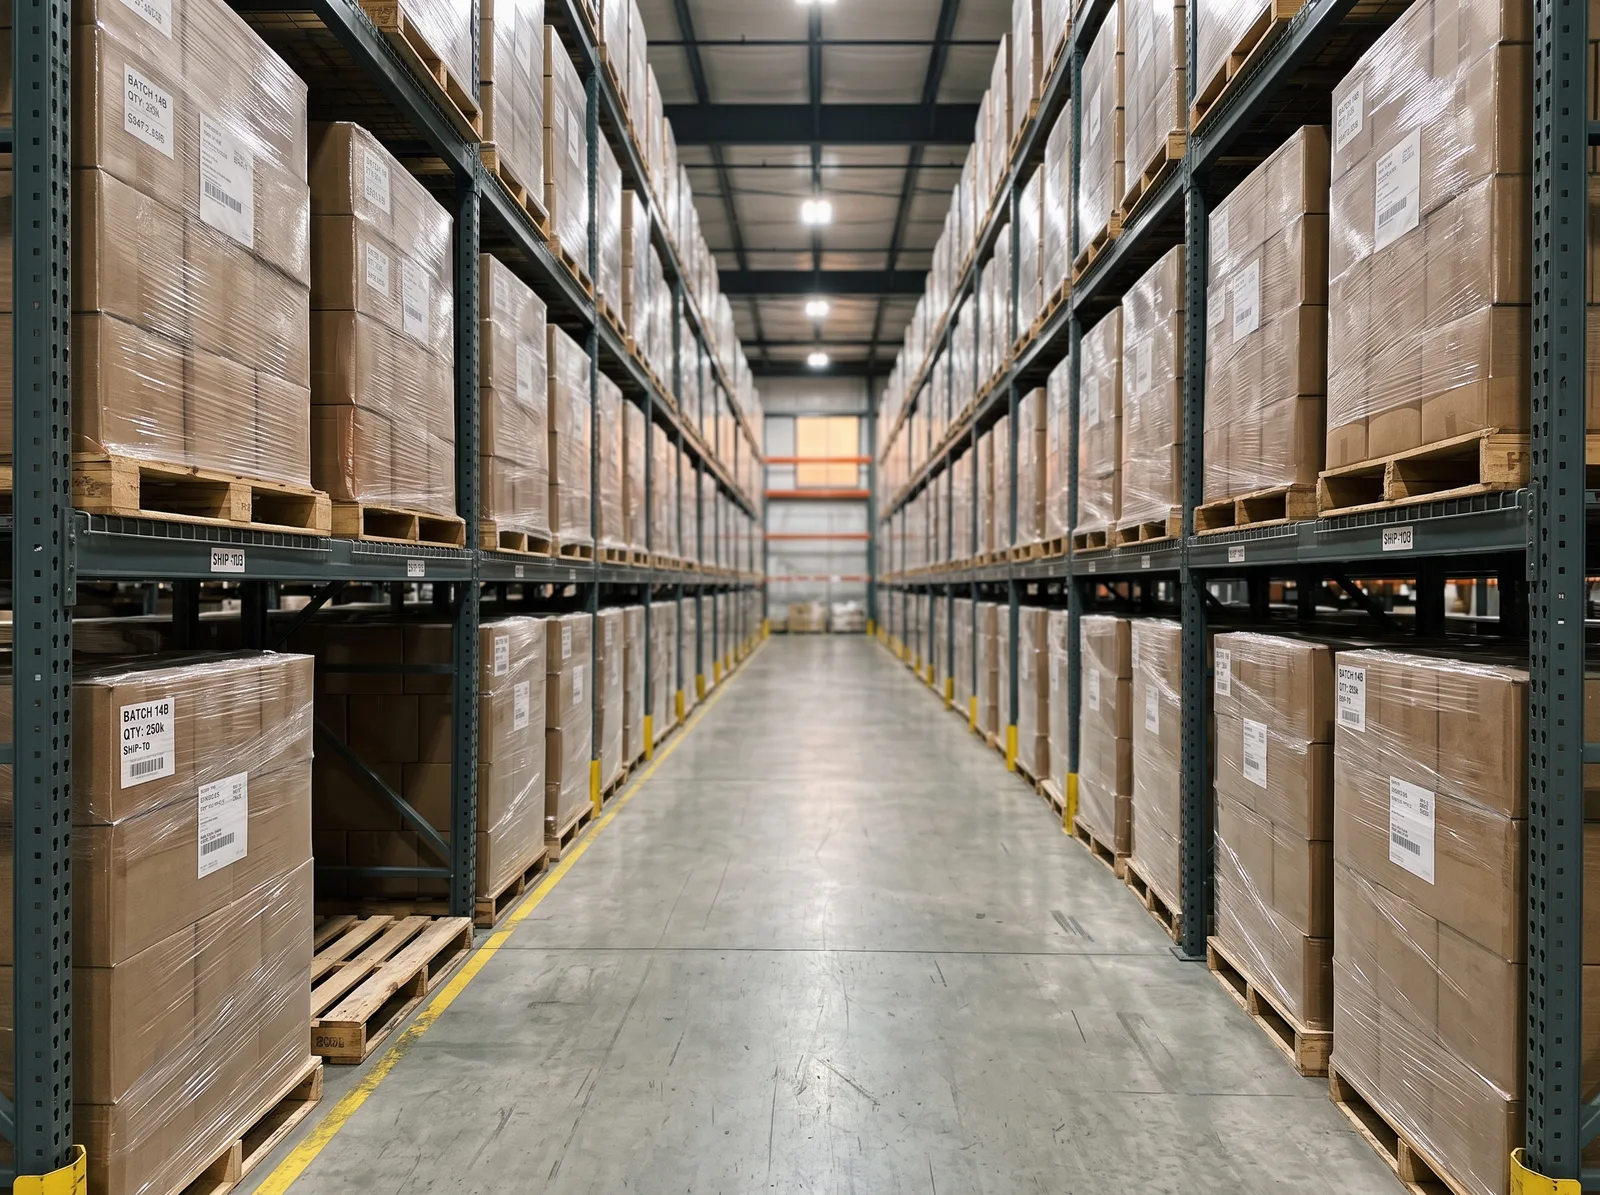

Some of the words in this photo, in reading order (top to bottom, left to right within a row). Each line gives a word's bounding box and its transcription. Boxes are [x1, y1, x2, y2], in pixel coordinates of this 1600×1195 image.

[128, 74, 153, 100] BATCH
[154, 94, 167, 109] 14B
[123, 706, 153, 723] BATCH
[154, 703, 169, 717] 14B
[123, 725, 144, 741] QTY:
[146, 722, 165, 736] 250k
